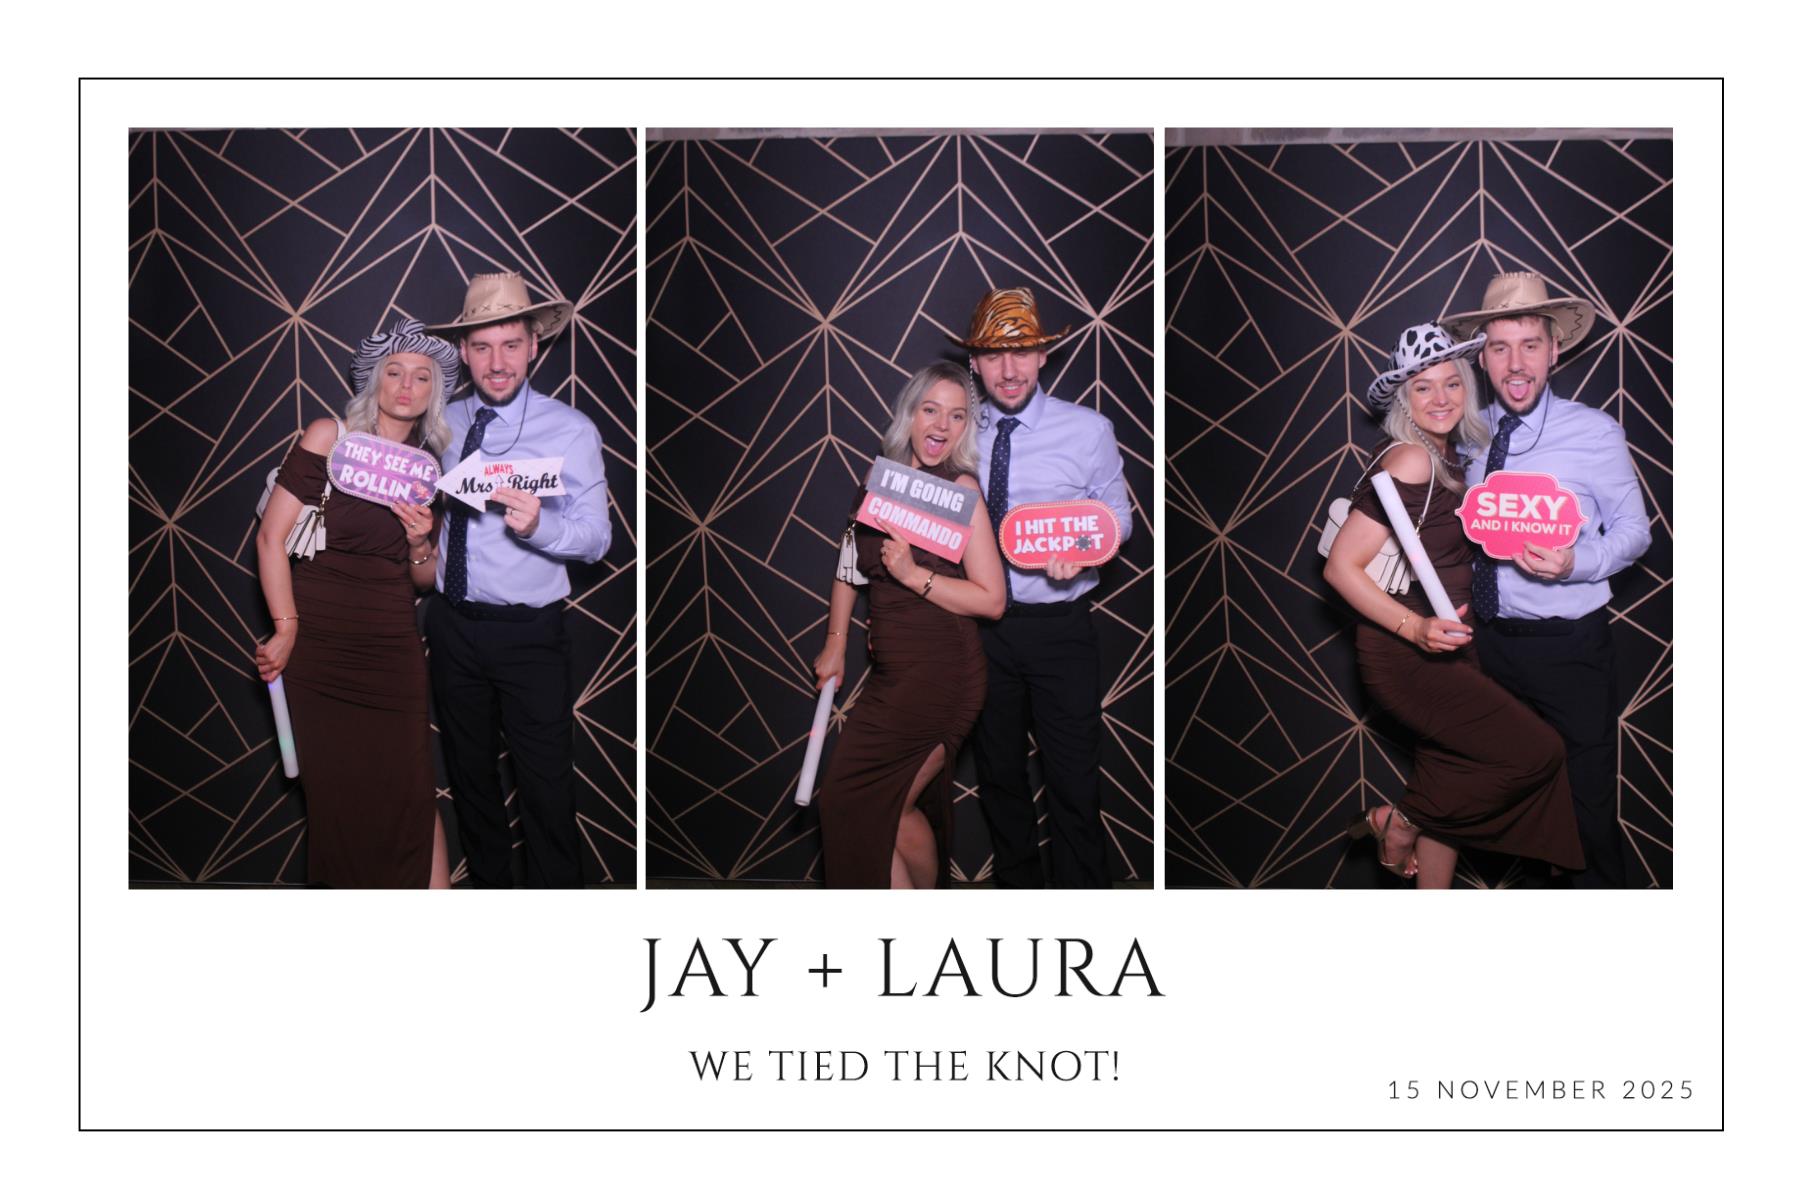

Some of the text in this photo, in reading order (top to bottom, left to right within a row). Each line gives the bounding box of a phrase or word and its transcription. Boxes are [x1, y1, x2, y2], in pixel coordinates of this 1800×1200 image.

[345, 441, 434, 482] THEY SEE ME
[484, 463, 514, 477] ALWAYS
[339, 464, 412, 500] ROLLIN
[455, 472, 559, 495] Mrs Right
[880, 468, 965, 513] I'M GOING
[1476, 492, 1568, 520] SEXY
[867, 496, 963, 551] COMMANDO
[1015, 515, 1099, 535] I HIT THE
[1470, 518, 1572, 536] AND I KNOW IT
